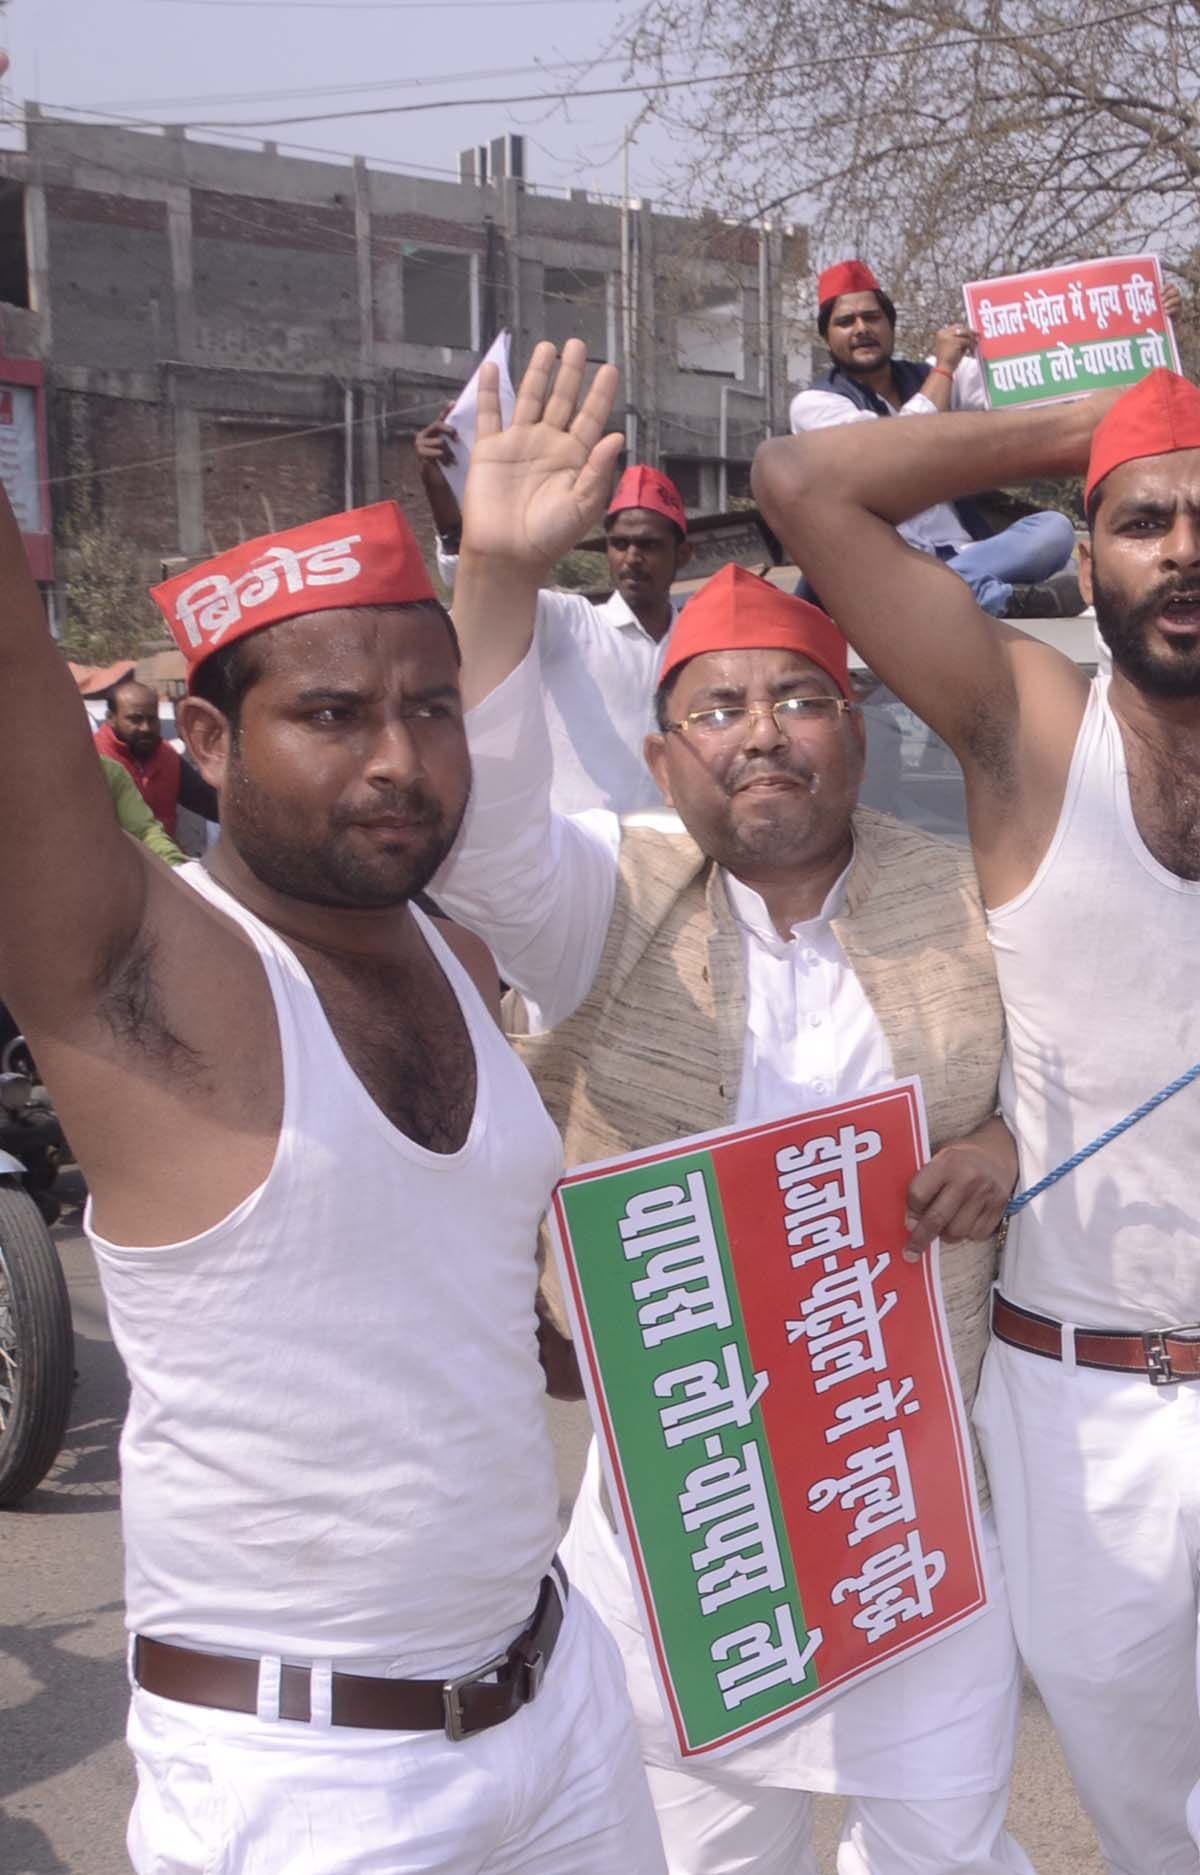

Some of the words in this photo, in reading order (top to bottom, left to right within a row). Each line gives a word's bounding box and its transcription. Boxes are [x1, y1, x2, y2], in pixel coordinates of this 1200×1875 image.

[989, 354, 1045, 392] वापस
[1136, 328, 1167, 368] लो
[1068, 281, 1087, 321] में
[1086, 284, 1123, 330] मूल्य
[176, 534, 362, 648] ब्रिगेड
[617, 1169, 735, 1351] वापस
[710, 1602, 824, 1712] लो
[824, 1375, 921, 1445] में
[807, 1428, 917, 1547] मूल्य
[830, 1528, 948, 1645] वृद्धि
